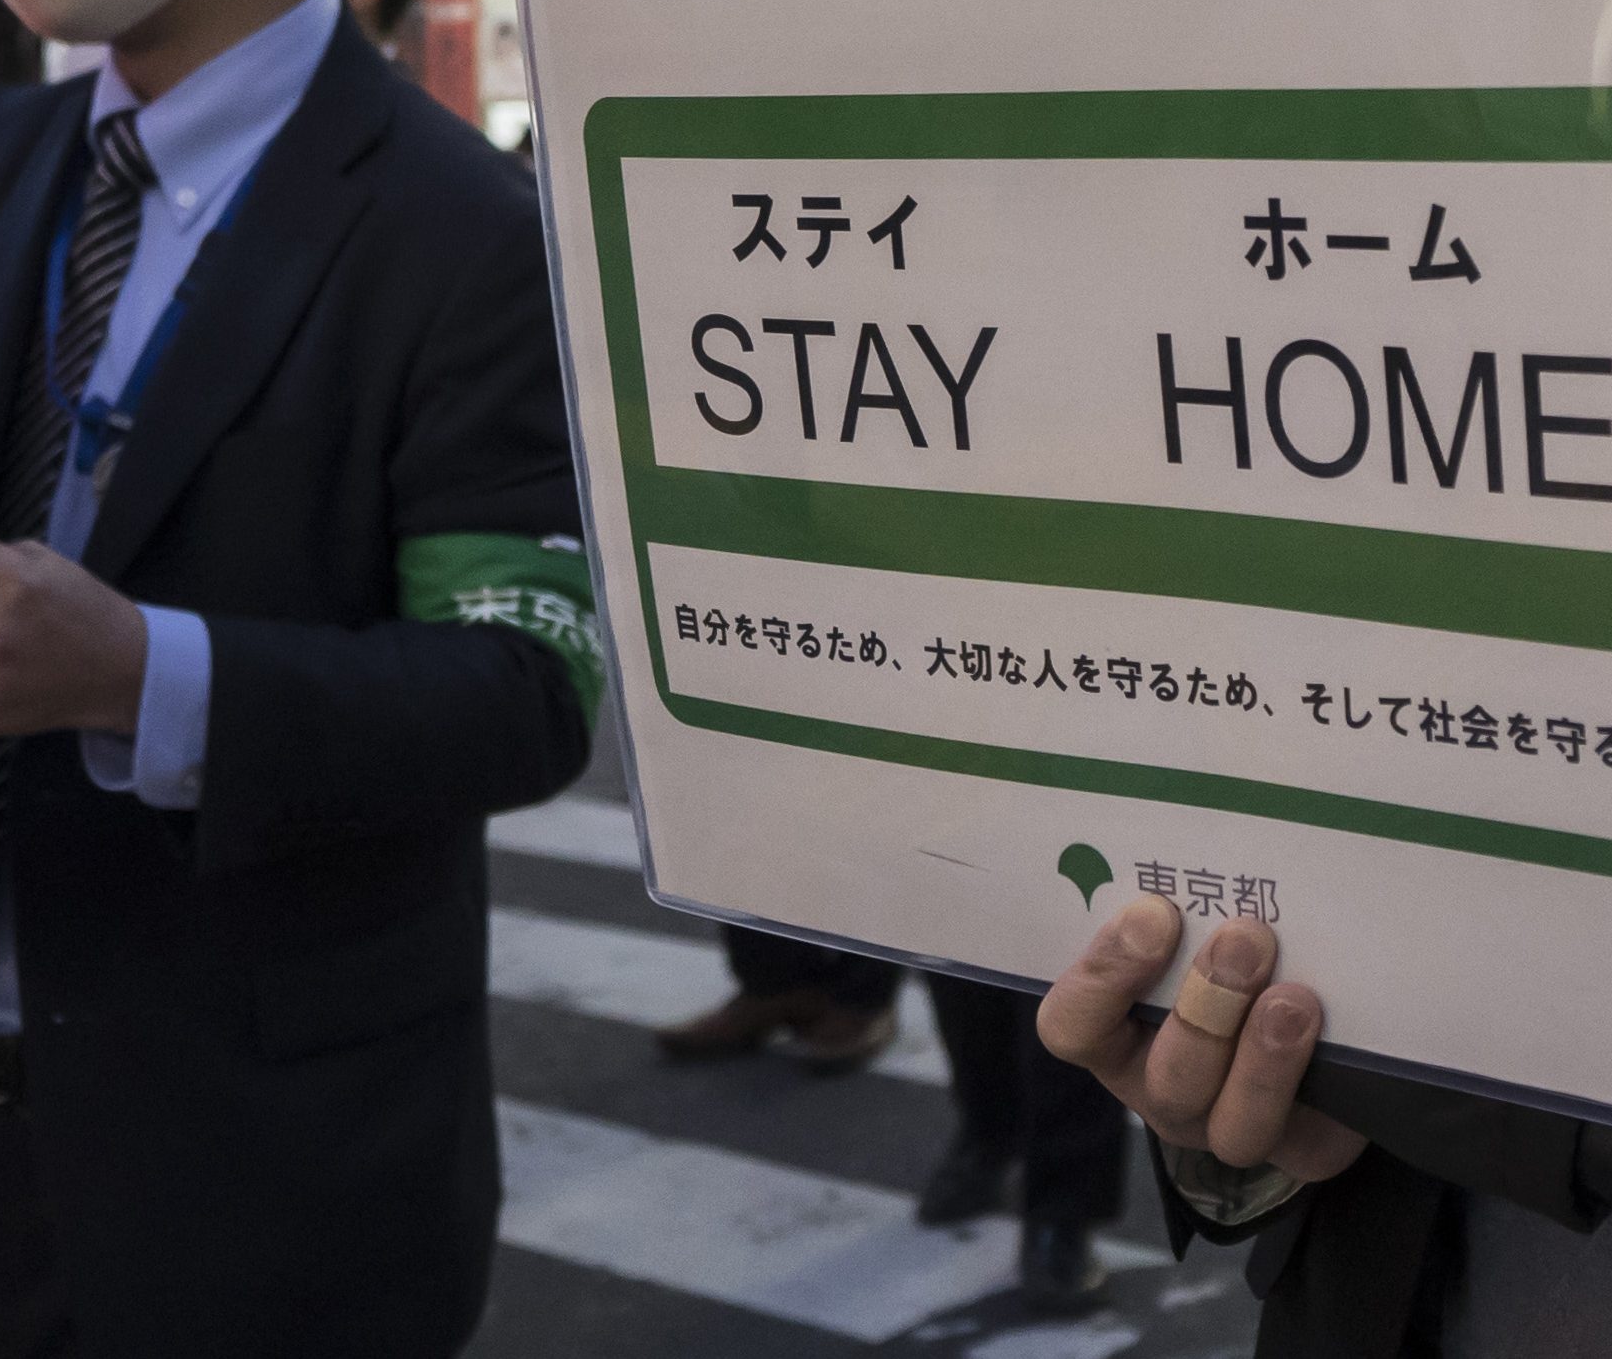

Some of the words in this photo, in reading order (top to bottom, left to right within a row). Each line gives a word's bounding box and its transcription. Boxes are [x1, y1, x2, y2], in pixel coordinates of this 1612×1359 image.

[731, 194, 918, 270] ステイ
[1243, 197, 1482, 284] ホーム
[690, 313, 999, 451] STAY
[1133, 859, 1281, 925] 東京都
